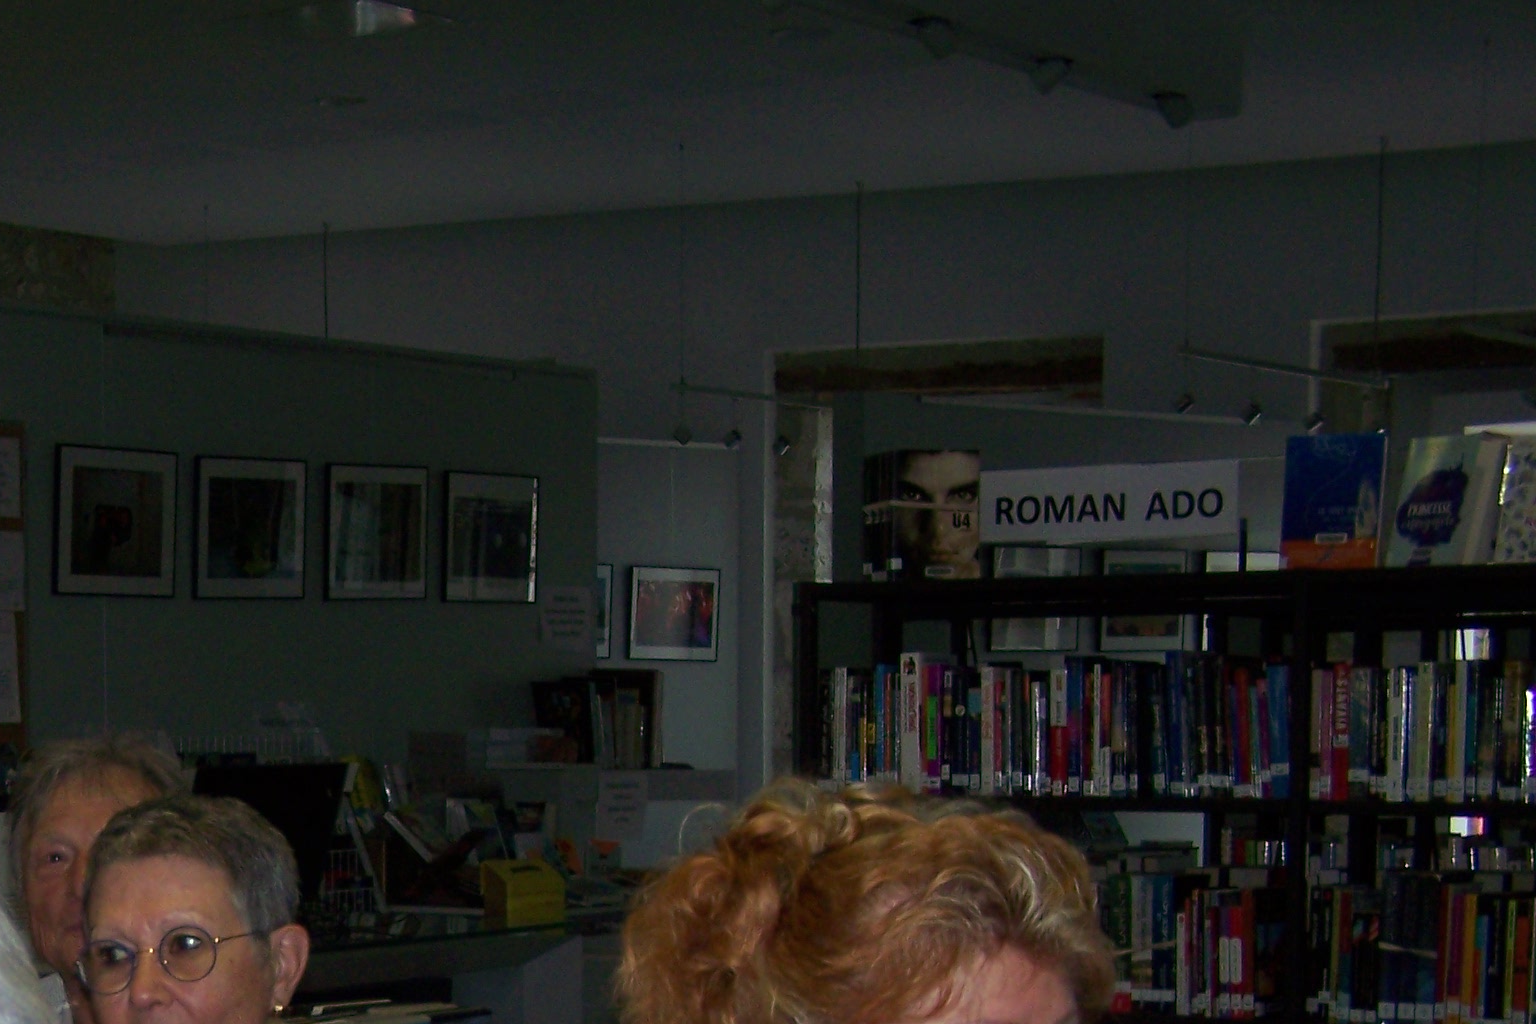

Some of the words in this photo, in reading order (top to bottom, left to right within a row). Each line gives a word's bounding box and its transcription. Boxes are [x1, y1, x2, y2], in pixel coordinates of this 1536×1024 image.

[996, 492, 1126, 525] ROMAN
[1145, 488, 1224, 521] ADO
[952, 512, 970, 529] U4
